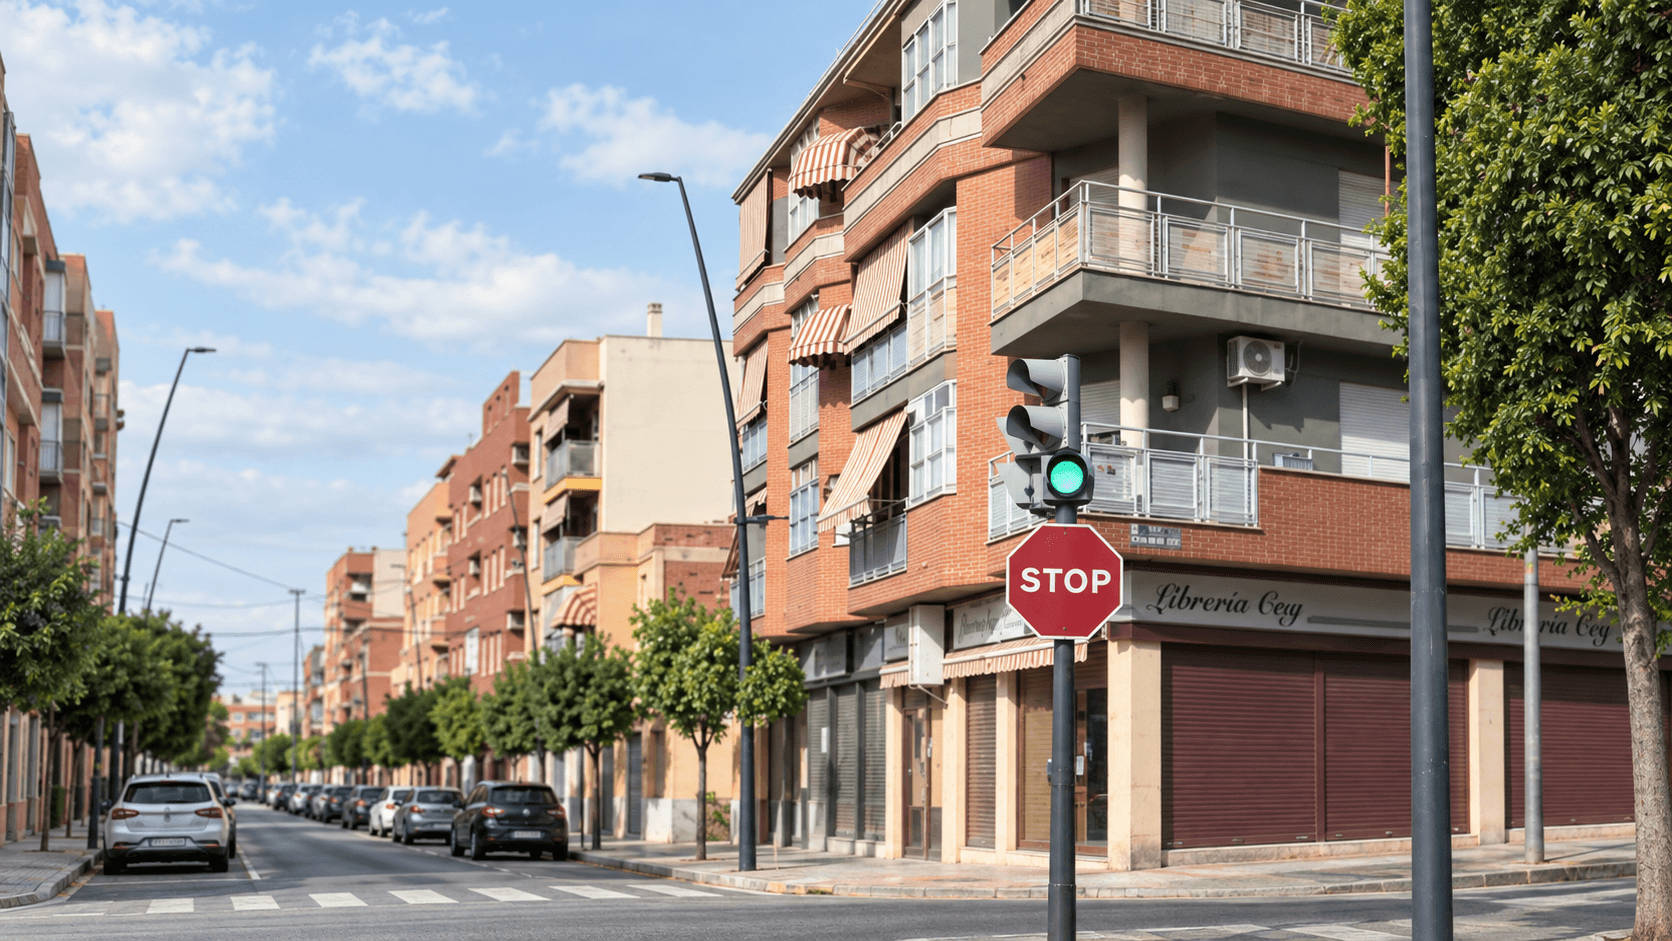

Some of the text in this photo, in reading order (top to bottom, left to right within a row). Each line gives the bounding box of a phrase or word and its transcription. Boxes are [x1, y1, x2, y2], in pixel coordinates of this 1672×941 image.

[1020, 567, 1112, 594] STOP
[1146, 583, 1250, 615] Librería
[1483, 606, 1569, 636] Librría
